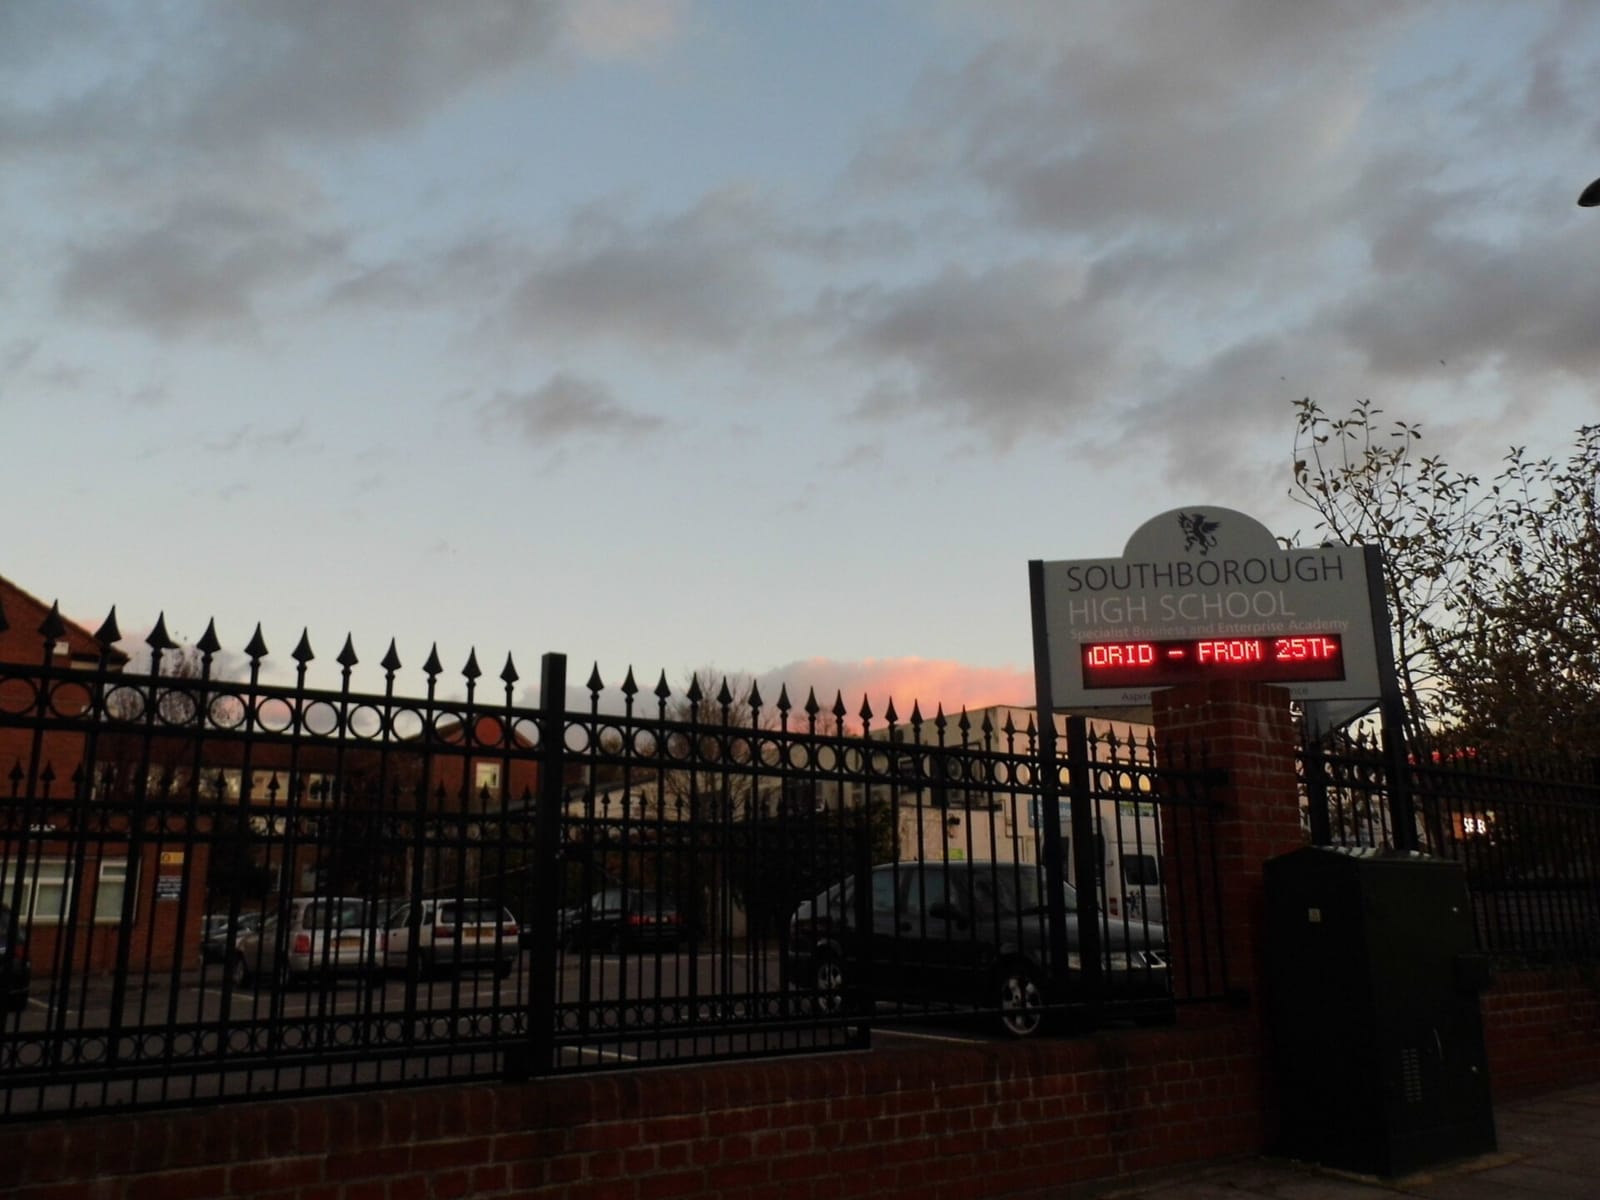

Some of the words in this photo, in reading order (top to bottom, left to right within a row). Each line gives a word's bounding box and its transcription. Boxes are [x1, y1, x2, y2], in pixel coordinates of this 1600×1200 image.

[1066, 554, 1344, 592] SOUTHBOROUGH
[1069, 596, 1148, 625] HIGH
[1159, 591, 1296, 621] SCHOOL
[1069, 626, 1129, 641] Specialist
[1132, 624, 1187, 638] Business
[1190, 623, 1214, 635] and
[1218, 620, 1284, 636] Enterprise
[1289, 617, 1349, 633] Academy
[1198, 641, 1261, 662] FROM
